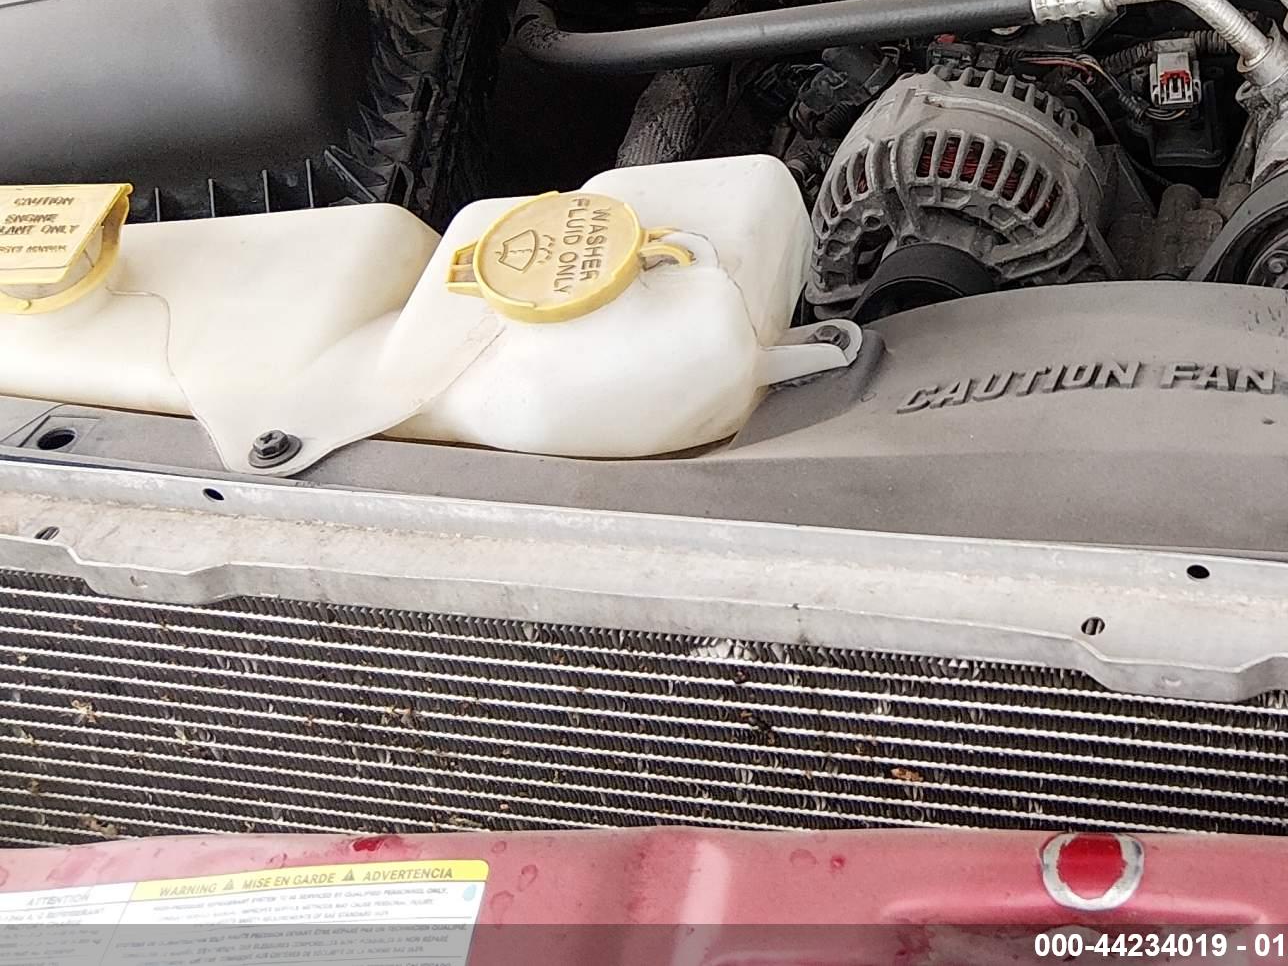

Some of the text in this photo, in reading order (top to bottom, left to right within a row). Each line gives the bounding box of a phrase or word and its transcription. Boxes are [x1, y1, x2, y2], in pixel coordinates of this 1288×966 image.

[13, 196, 75, 206] CAUTION
[5, 213, 59, 224] ENGINE
[40, 224, 81, 235] ONLY
[553, 197, 590, 294] FLUID ONLY
[579, 206, 612, 282] WASHER
[896, 361, 1276, 414] CAUTION FAN
[159, 868, 453, 897] WARNING MISE EN GARDE ADVERTENCIA
